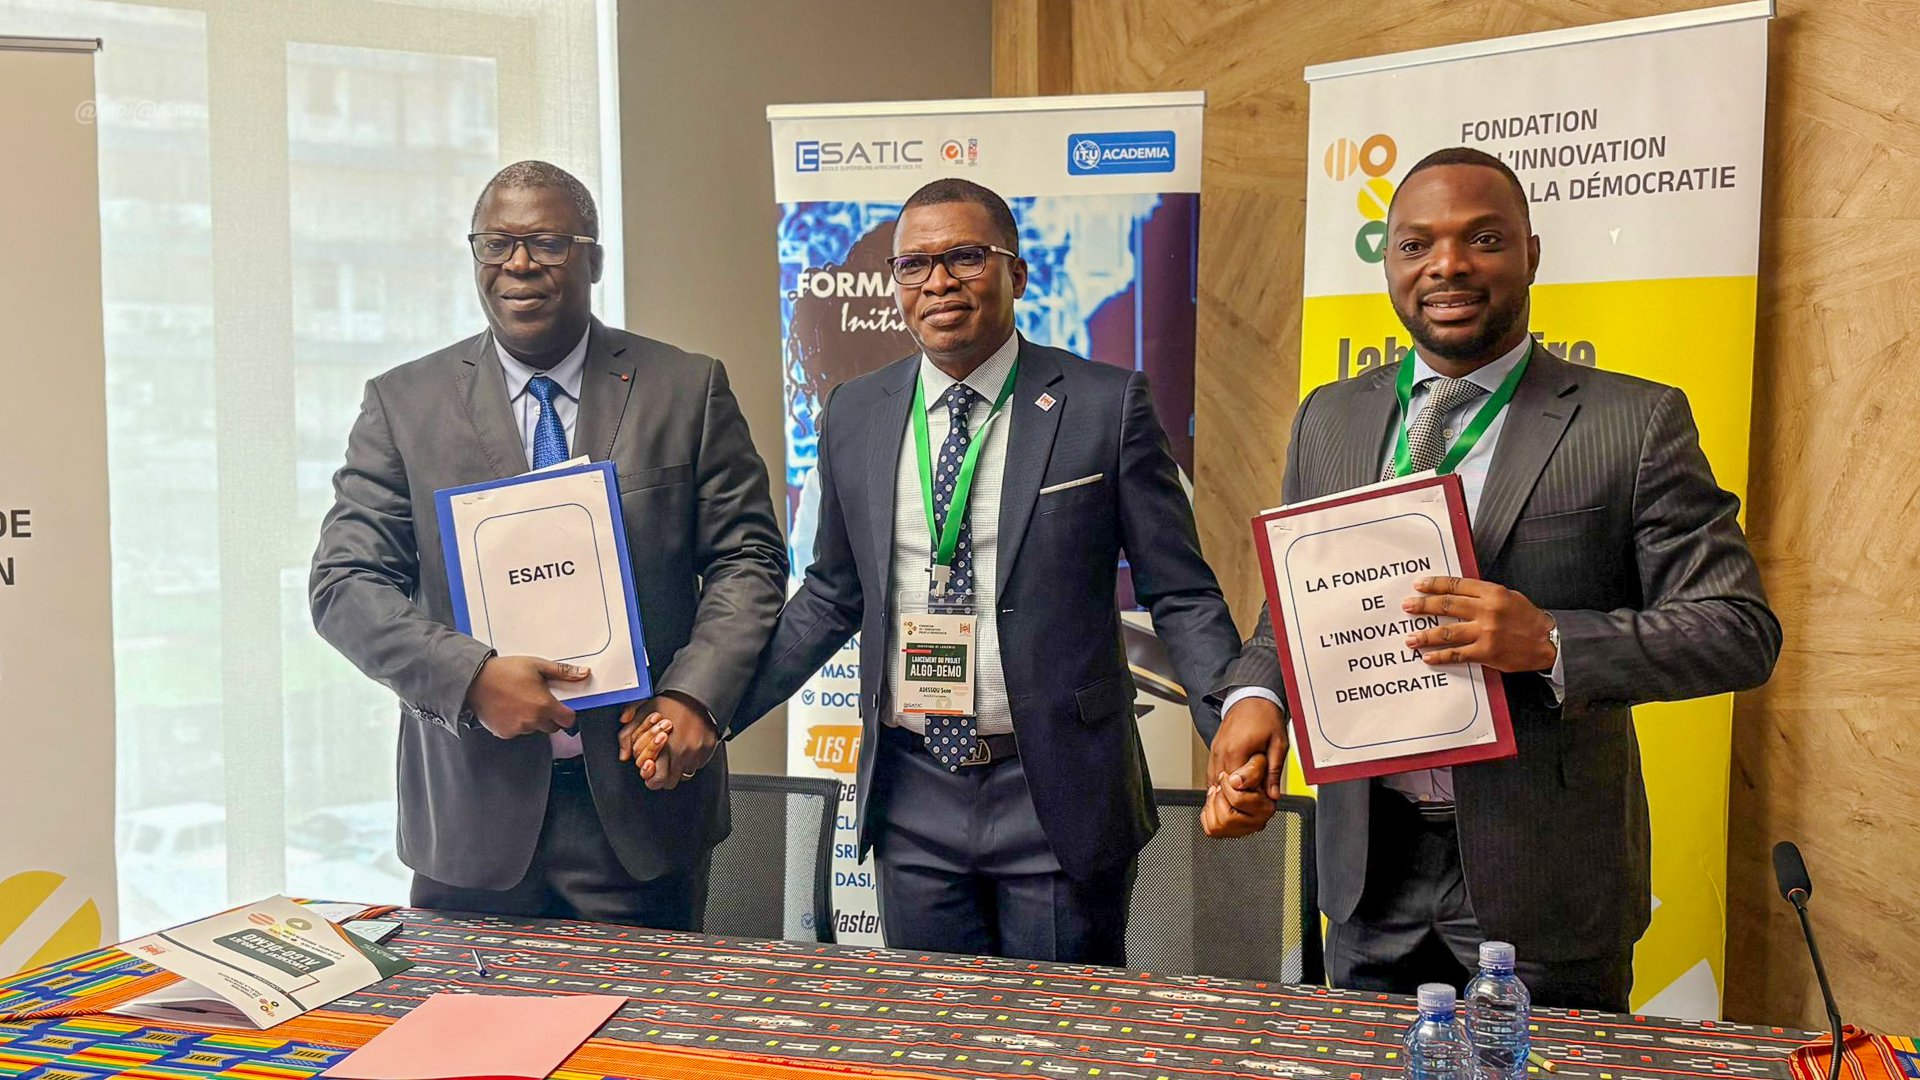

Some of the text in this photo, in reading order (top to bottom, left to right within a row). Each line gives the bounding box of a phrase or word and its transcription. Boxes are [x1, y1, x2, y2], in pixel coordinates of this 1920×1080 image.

[1461, 108, 1598, 143] FONDATION
[796, 140, 923, 172] ESATIC
[1075, 146, 1169, 161] ITU ACADEMIA
[1530, 166, 1736, 203] LA DÉMOCRATIE
[508, 560, 576, 585] ESATIC
[1305, 557, 1431, 593] LA FONDATION
[1361, 595, 1386, 611] DE
[1320, 615, 1440, 648] L'INNOVATION
[910, 664, 962, 677] ALGO-DEMO
[1348, 648, 1423, 672] POUR LA
[1336, 673, 1449, 703] DEMOCRATIE
[815, 735, 847, 763] LES
[835, 873, 875, 890] DASI,
[241, 933, 321, 966] ALGO-DEMO
